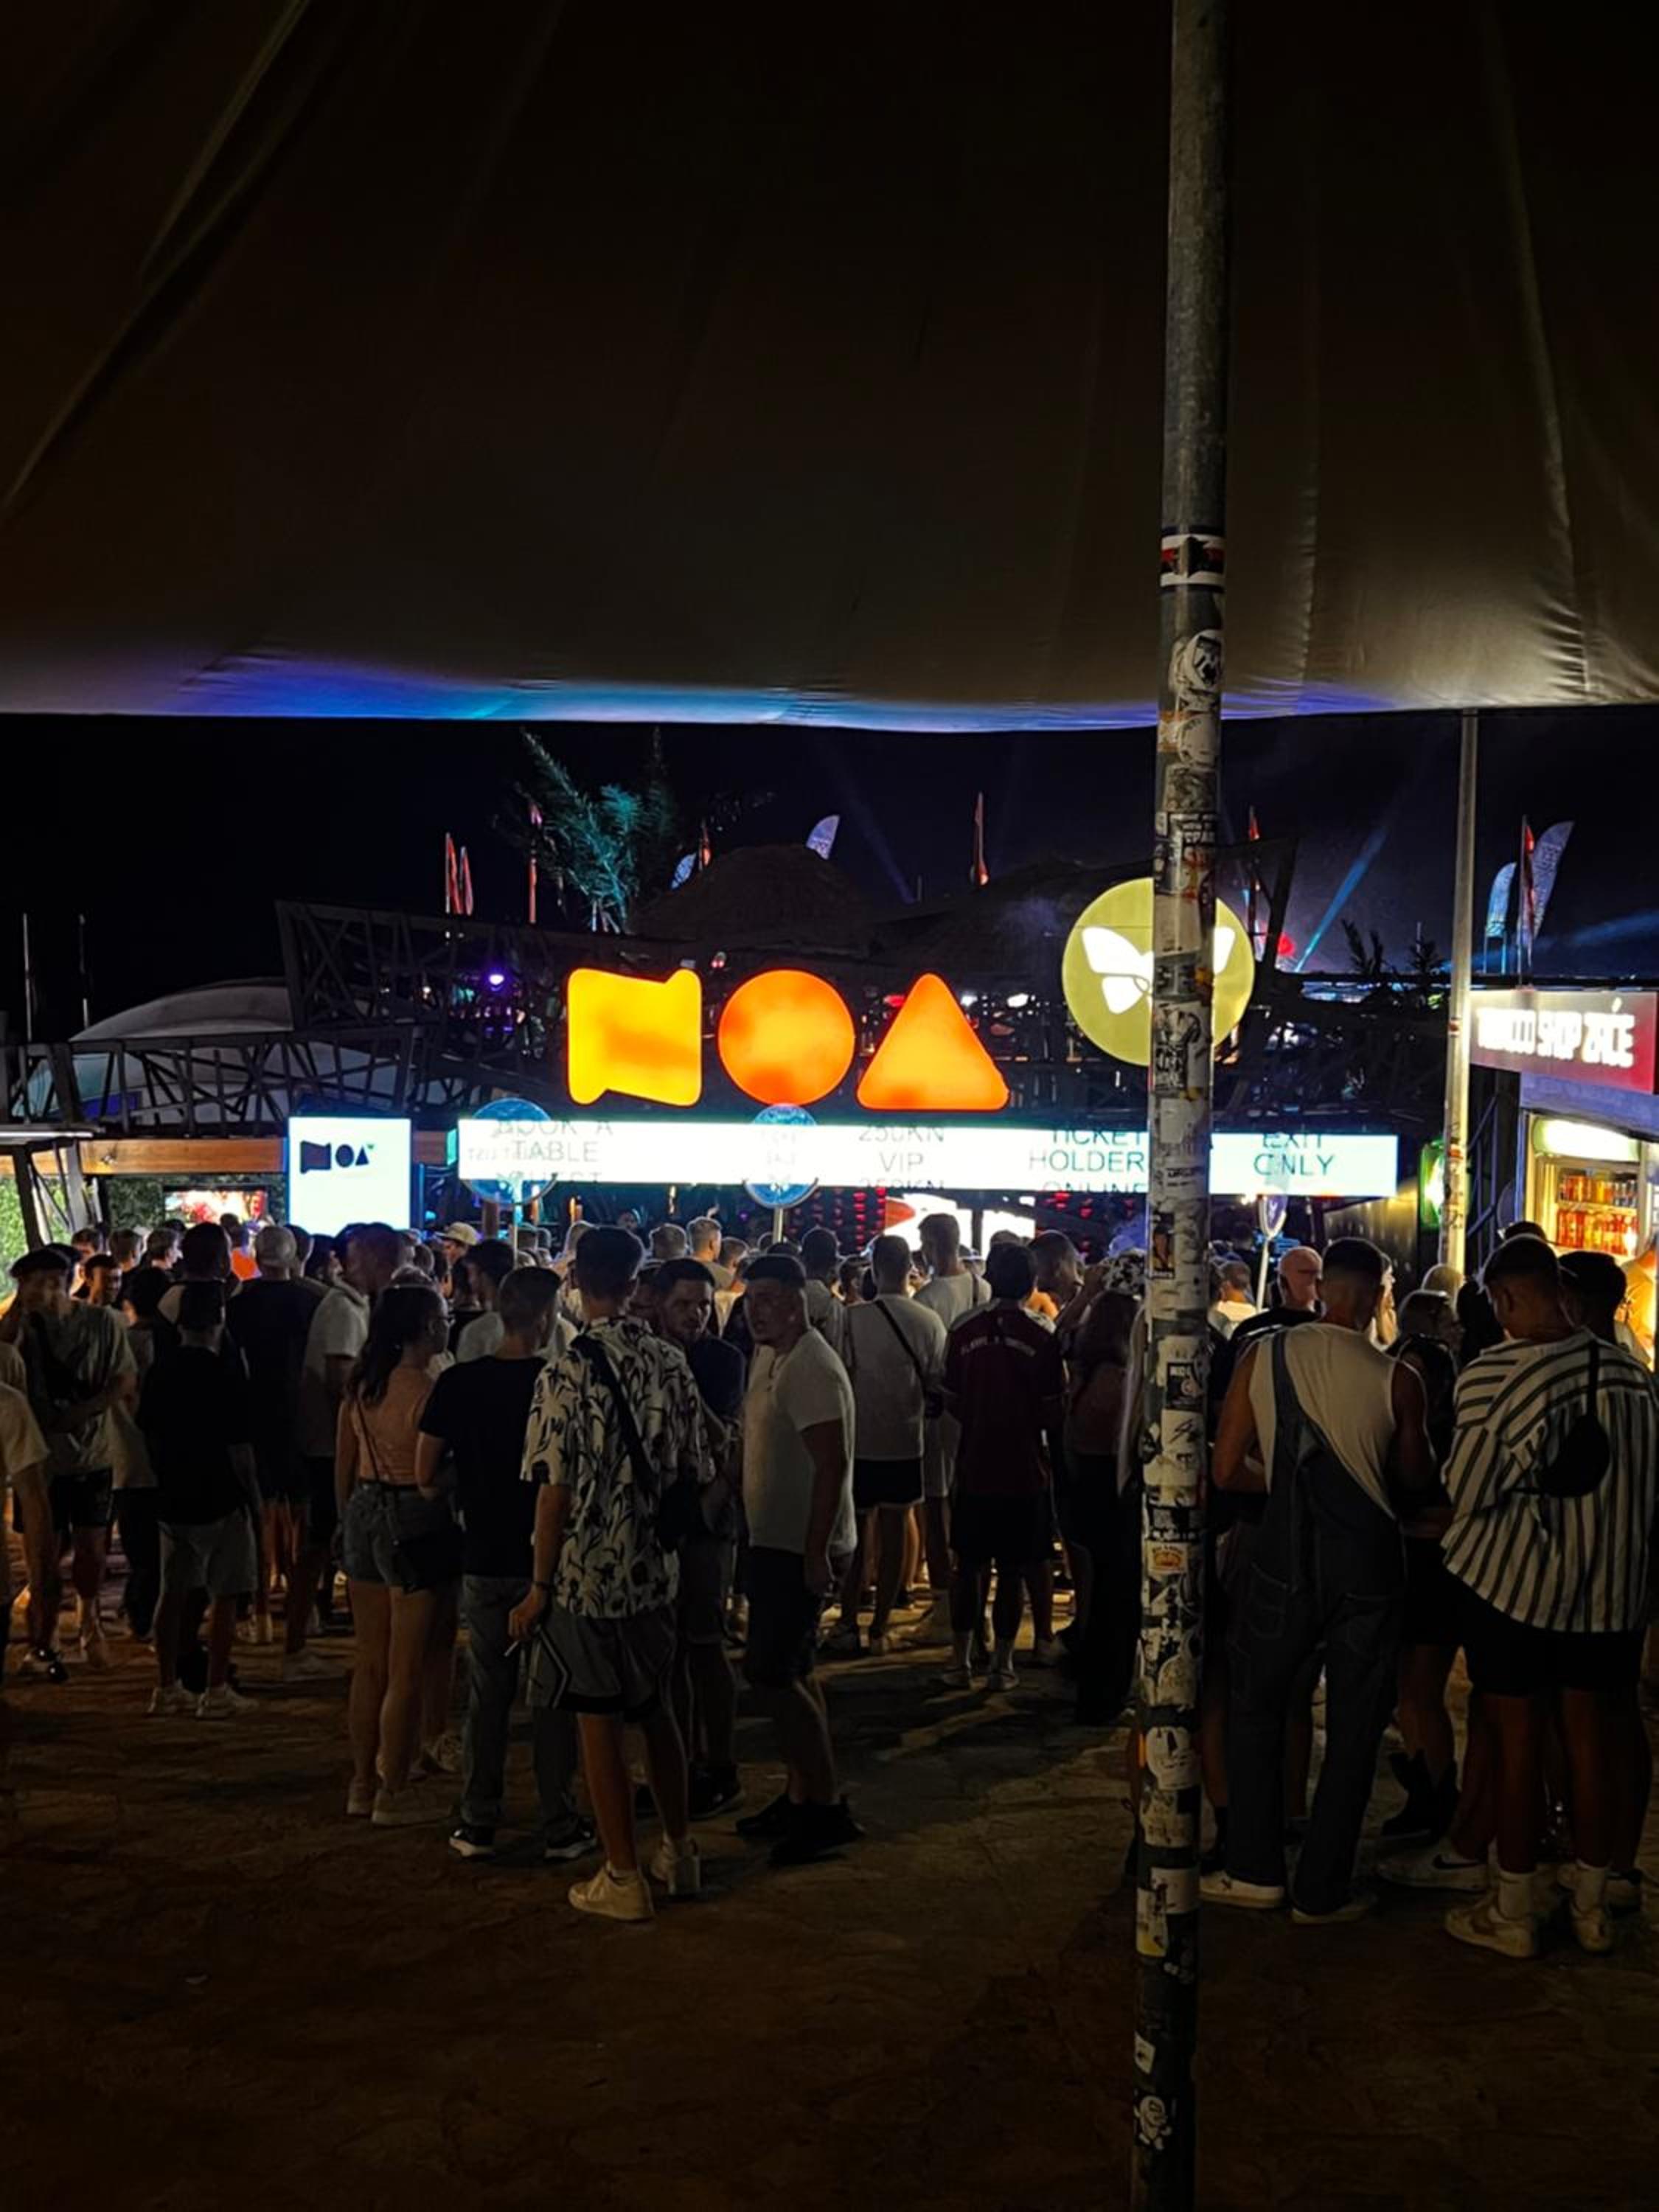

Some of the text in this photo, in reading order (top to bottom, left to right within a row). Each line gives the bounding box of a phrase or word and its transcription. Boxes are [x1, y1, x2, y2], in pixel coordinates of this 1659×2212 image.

[513, 1140, 599, 1163] TABLE
[879, 1152, 923, 1173] VIP
[1029, 1149, 1146, 1173] HOLDER
